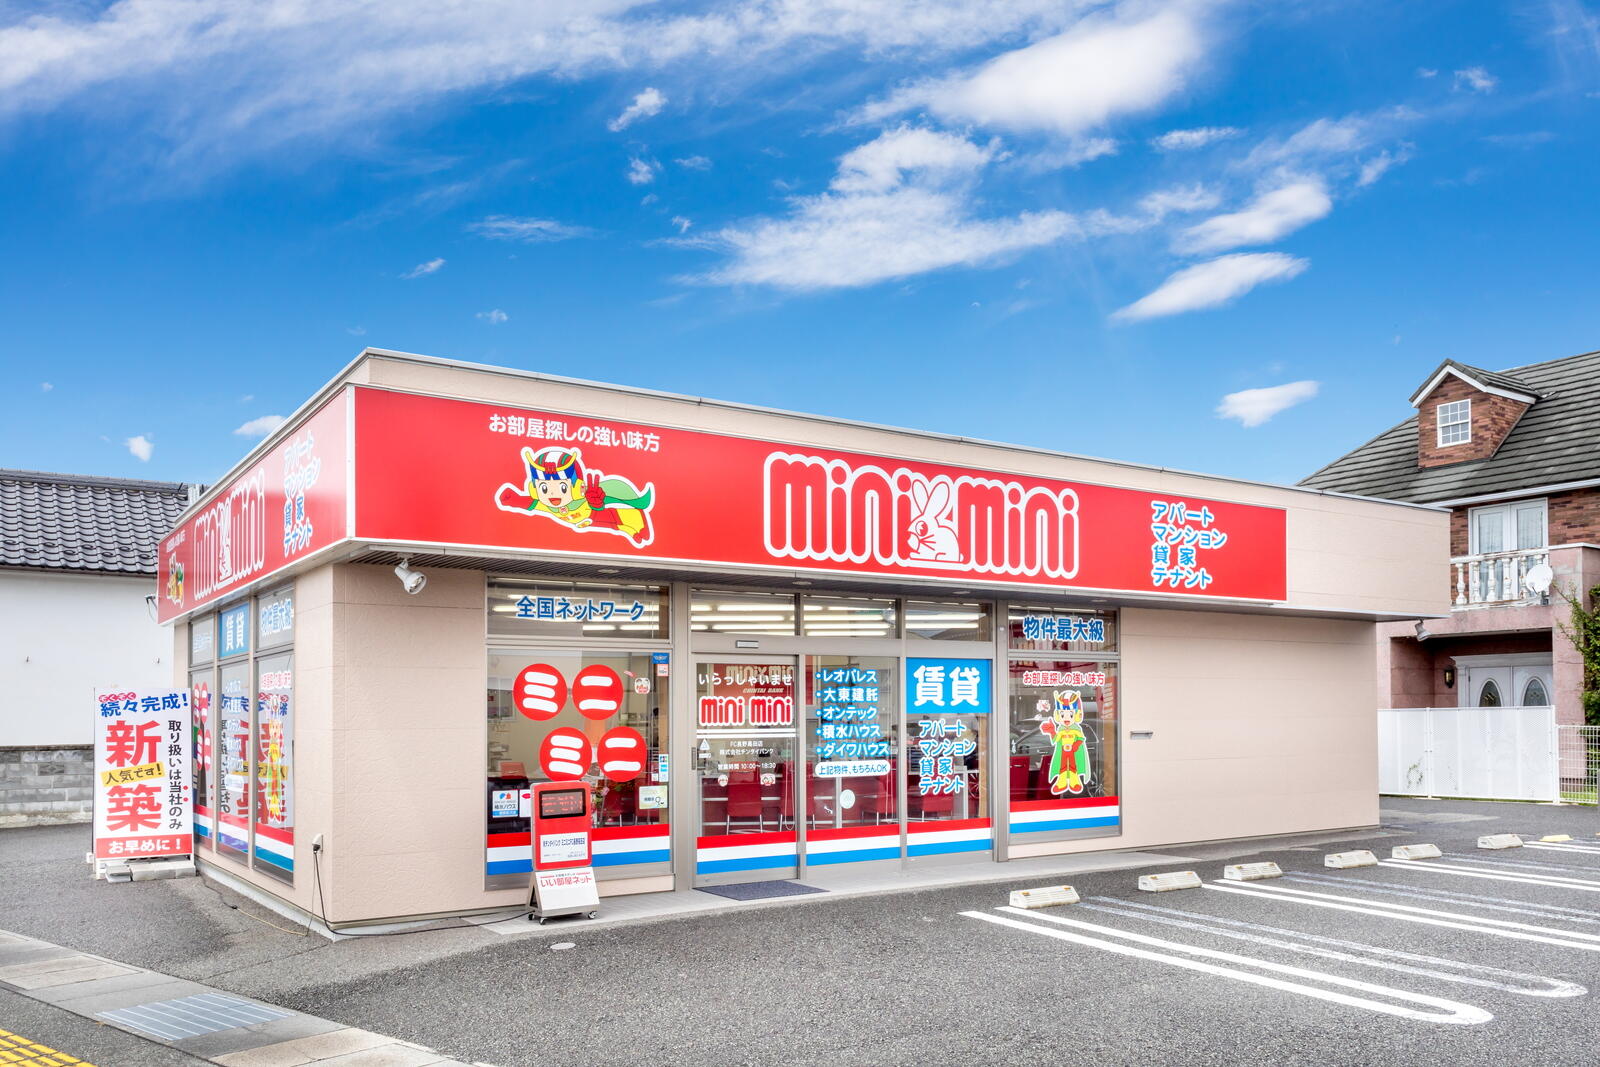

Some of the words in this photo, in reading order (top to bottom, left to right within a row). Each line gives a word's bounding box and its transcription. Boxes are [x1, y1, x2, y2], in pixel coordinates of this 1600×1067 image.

[489, 414, 660, 452] お部屋探しの強い味方
[764, 451, 911, 567] mini
[953, 475, 1079, 579] mini
[1151, 501, 1214, 528] アパート
[1151, 523, 1227, 550] マンション
[1151, 565, 1212, 589] テナント
[515, 595, 645, 621] 全国ネットワーク
[1023, 615, 1105, 643] 物件最大級
[698, 672, 792, 686] いらっしゃいませ
[913, 665, 981, 706] 賃貸
[1022, 670, 1106, 687] お部屋探しの強い味方
[99, 692, 189, 717] 続々完成!
[699, 696, 746, 726] mini
[748, 696, 793, 725] mini
[919, 719, 967, 738] アパート
[919, 739, 976, 757] マンション
[104, 763, 163, 785] 人気です!
[168, 720, 183, 830] 取り扱いは当社のみ
[919, 775, 965, 795] テナント
[108, 838, 182, 855] お早めに!
